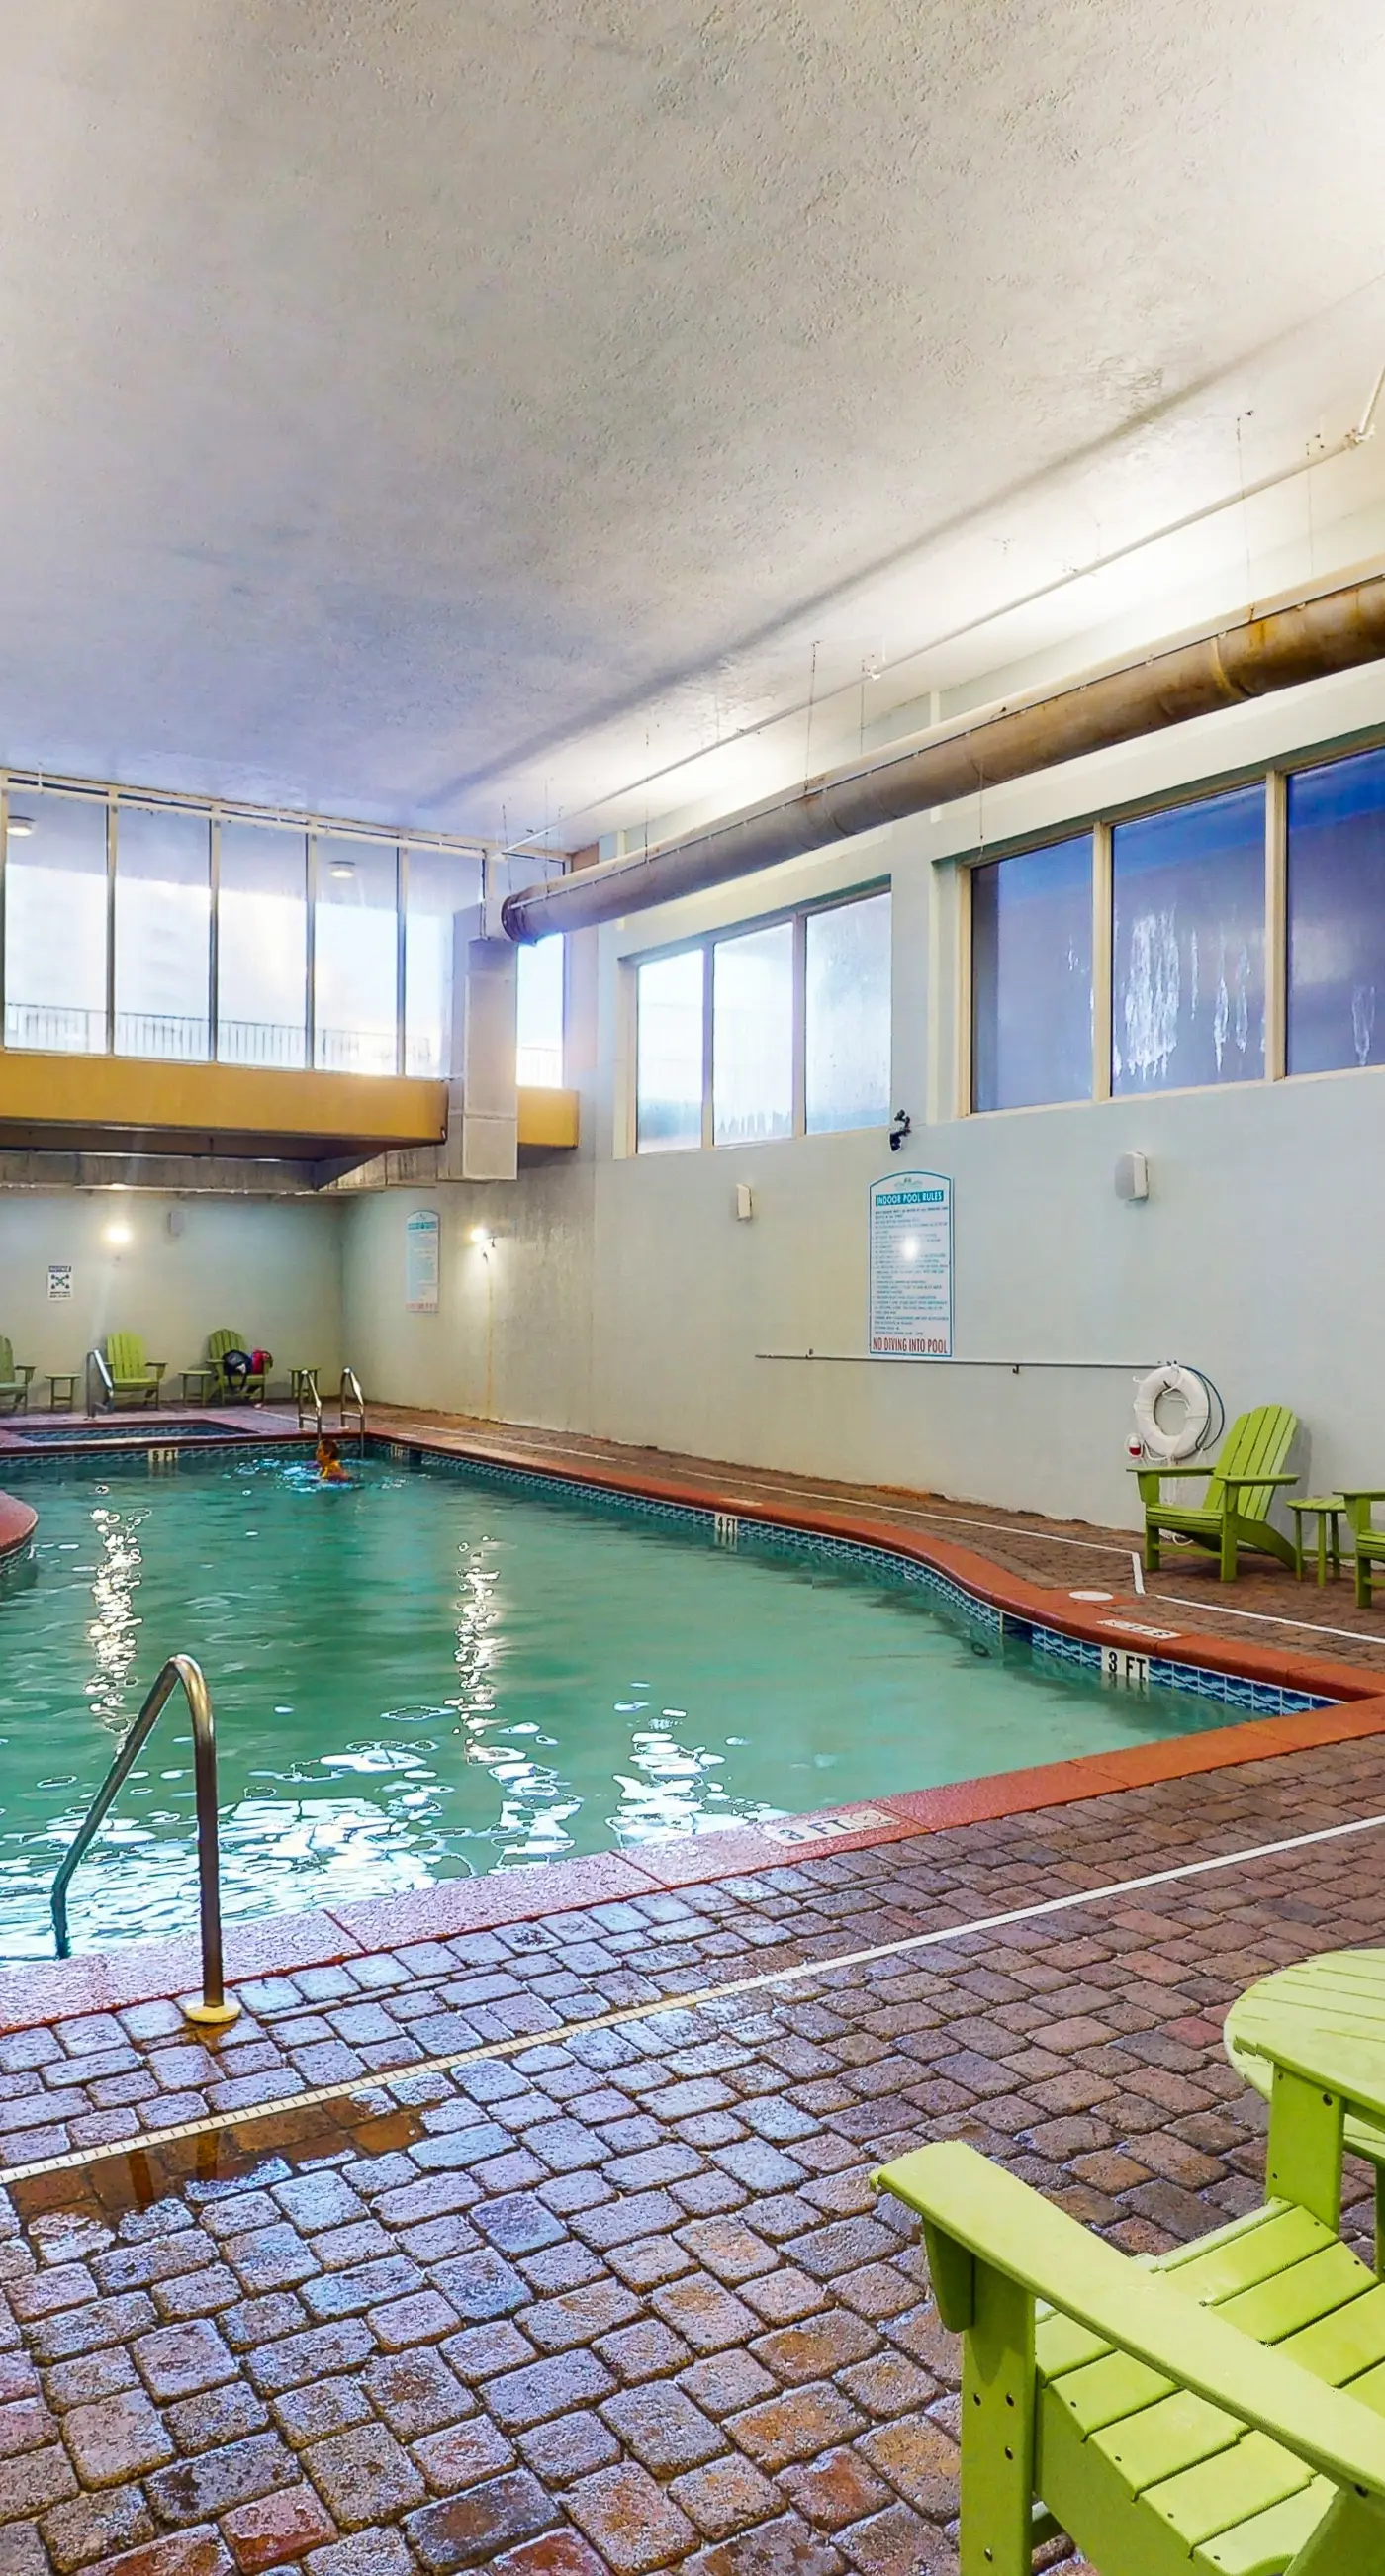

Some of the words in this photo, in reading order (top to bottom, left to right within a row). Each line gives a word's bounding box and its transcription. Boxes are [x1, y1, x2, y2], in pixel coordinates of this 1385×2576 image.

[877, 1194, 901, 1205] INDOOR
[903, 1193, 921, 1204] POOL
[922, 1191, 943, 1202] RULES
[873, 1337, 882, 1351] NO
[883, 1338, 907, 1352] DIVING
[909, 1339, 925, 1353] INTO
[927, 1339, 948, 1354] POOL
[1108, 1651, 1118, 1673] 3
